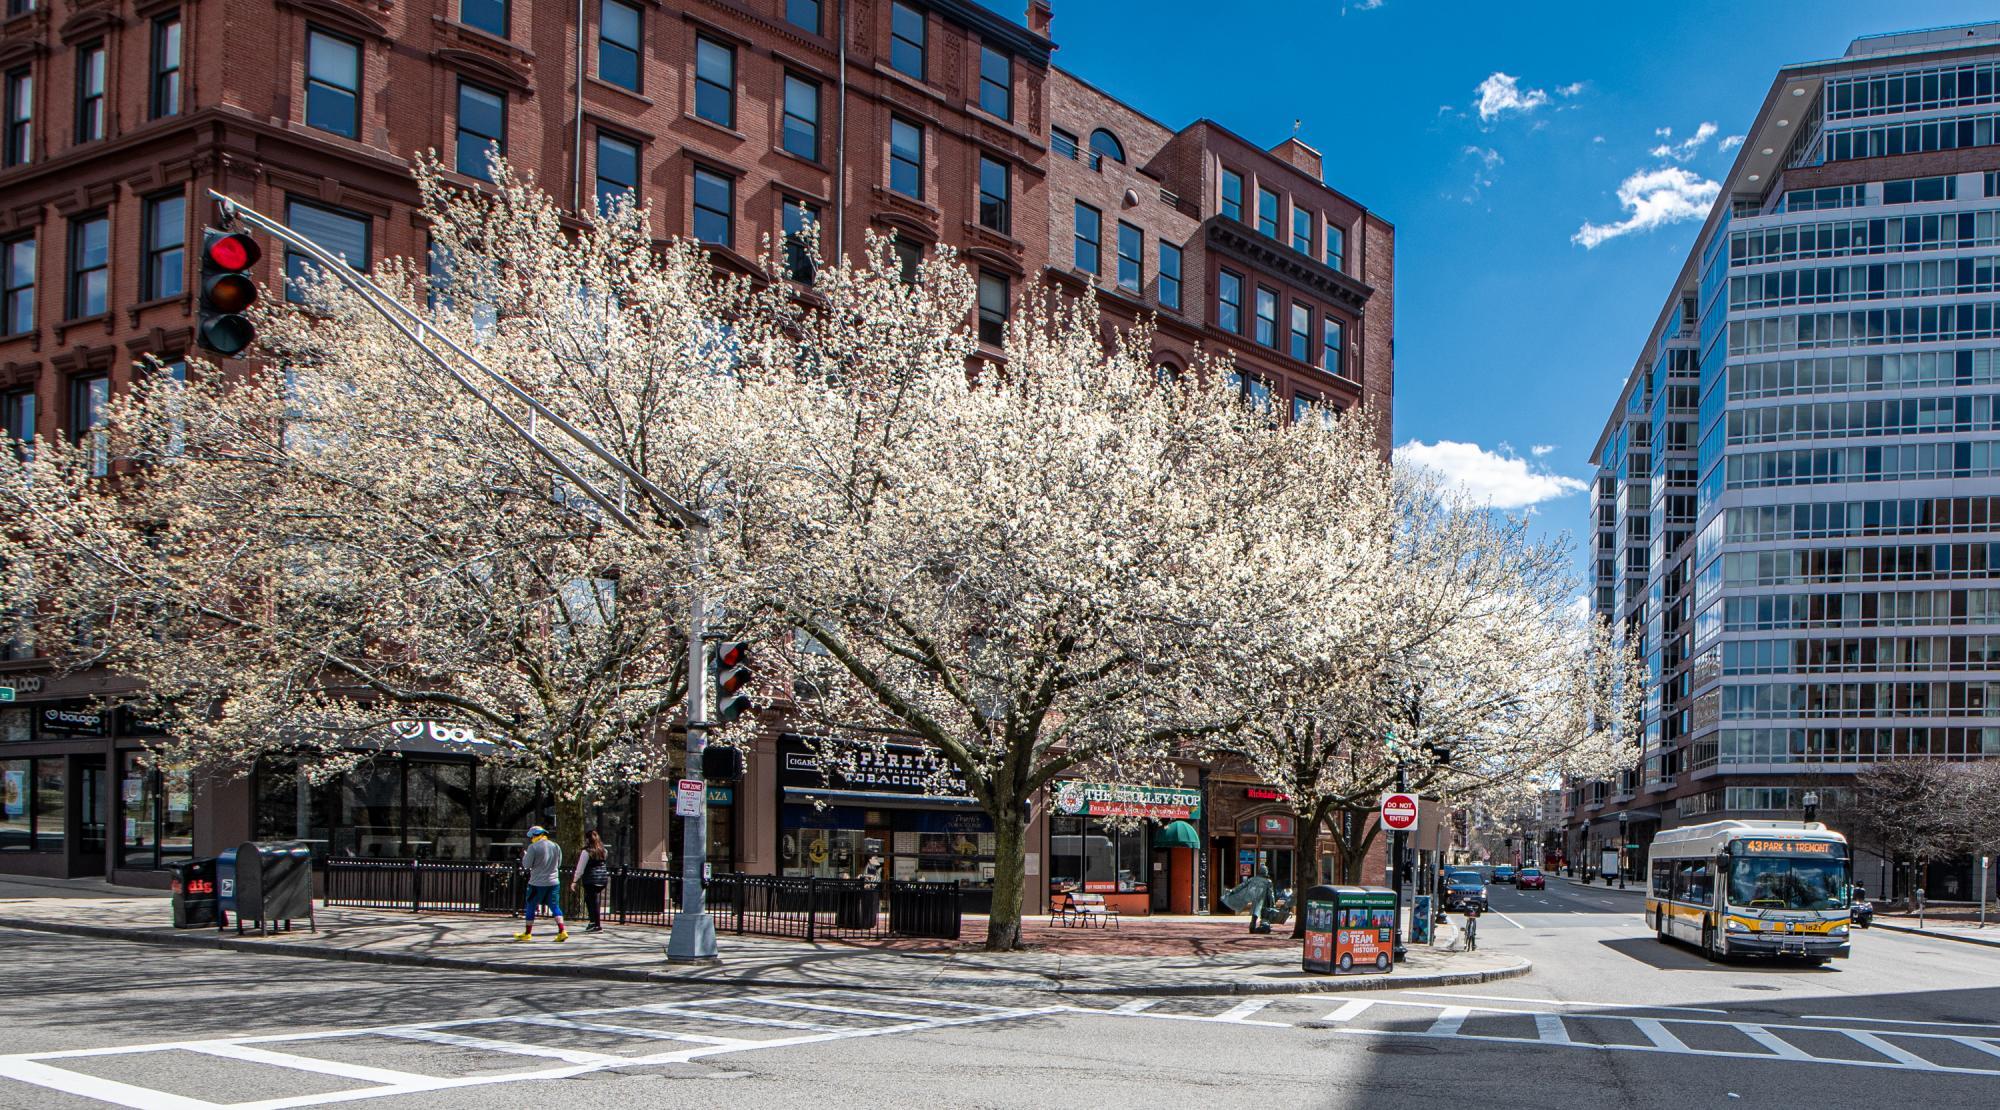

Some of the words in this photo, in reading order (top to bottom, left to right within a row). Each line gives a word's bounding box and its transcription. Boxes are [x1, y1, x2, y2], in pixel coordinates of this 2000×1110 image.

[861, 752, 962, 773] PERETT
[862, 767, 928, 776] ESTABLISHED
[845, 772, 966, 791] TOBACCONSTS
[1085, 788, 1112, 802] THE
[1172, 793, 1200, 806] STOP
[1748, 841, 1763, 852] 43
[1763, 842, 1784, 852] PARK
[1796, 843, 1830, 853] TREMONT
[188, 880, 213, 893] dig
[1350, 934, 1373, 944] TEAM
[1353, 946, 1379, 954] HISTORY!
